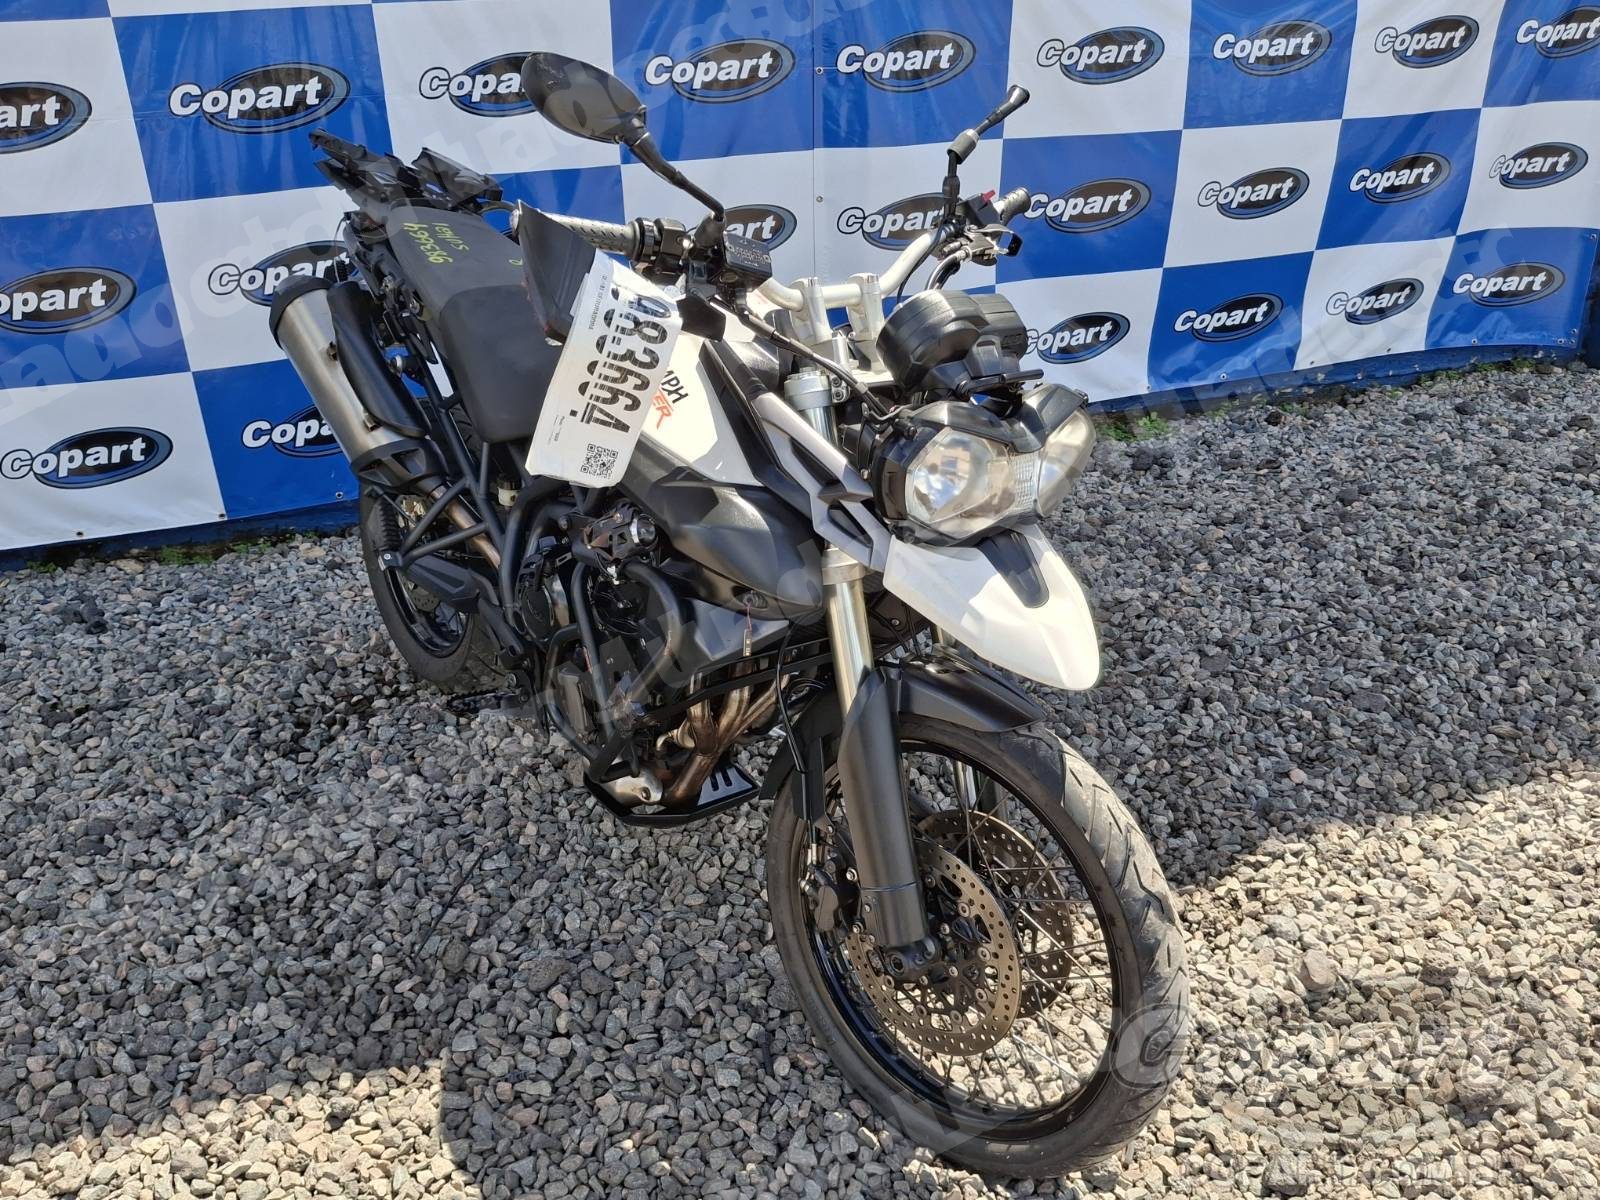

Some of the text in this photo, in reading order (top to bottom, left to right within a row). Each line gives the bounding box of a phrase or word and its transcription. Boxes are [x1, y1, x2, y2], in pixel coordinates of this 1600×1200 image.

[1213, 33, 1314, 64] Copart
[1375, 25, 1466, 56] Copart
[1516, 17, 1600, 48] Copart
[645, 51, 774, 90] Copart
[836, 42, 956, 75] Copart
[1037, 37, 1147, 71] Copart
[169, 76, 322, 119] Copart
[419, 67, 526, 102] Copa
[0, 95, 61, 128] art
[1350, 161, 1435, 194] Copart
[1489, 152, 1570, 178] Copart
[1024, 187, 1132, 222] Copart
[1198, 178, 1294, 209] Copart
[726, 215, 776, 239] art
[837, 206, 945, 239] Copar
[0, 278, 107, 321] part
[1453, 272, 1548, 297] Copart
[1174, 301, 1269, 335] Copart
[1326, 286, 1411, 319] Copart
[1024, 320, 1113, 355] Copart
[242, 418, 334, 449] Cop
[0, 437, 146, 480] Copart
